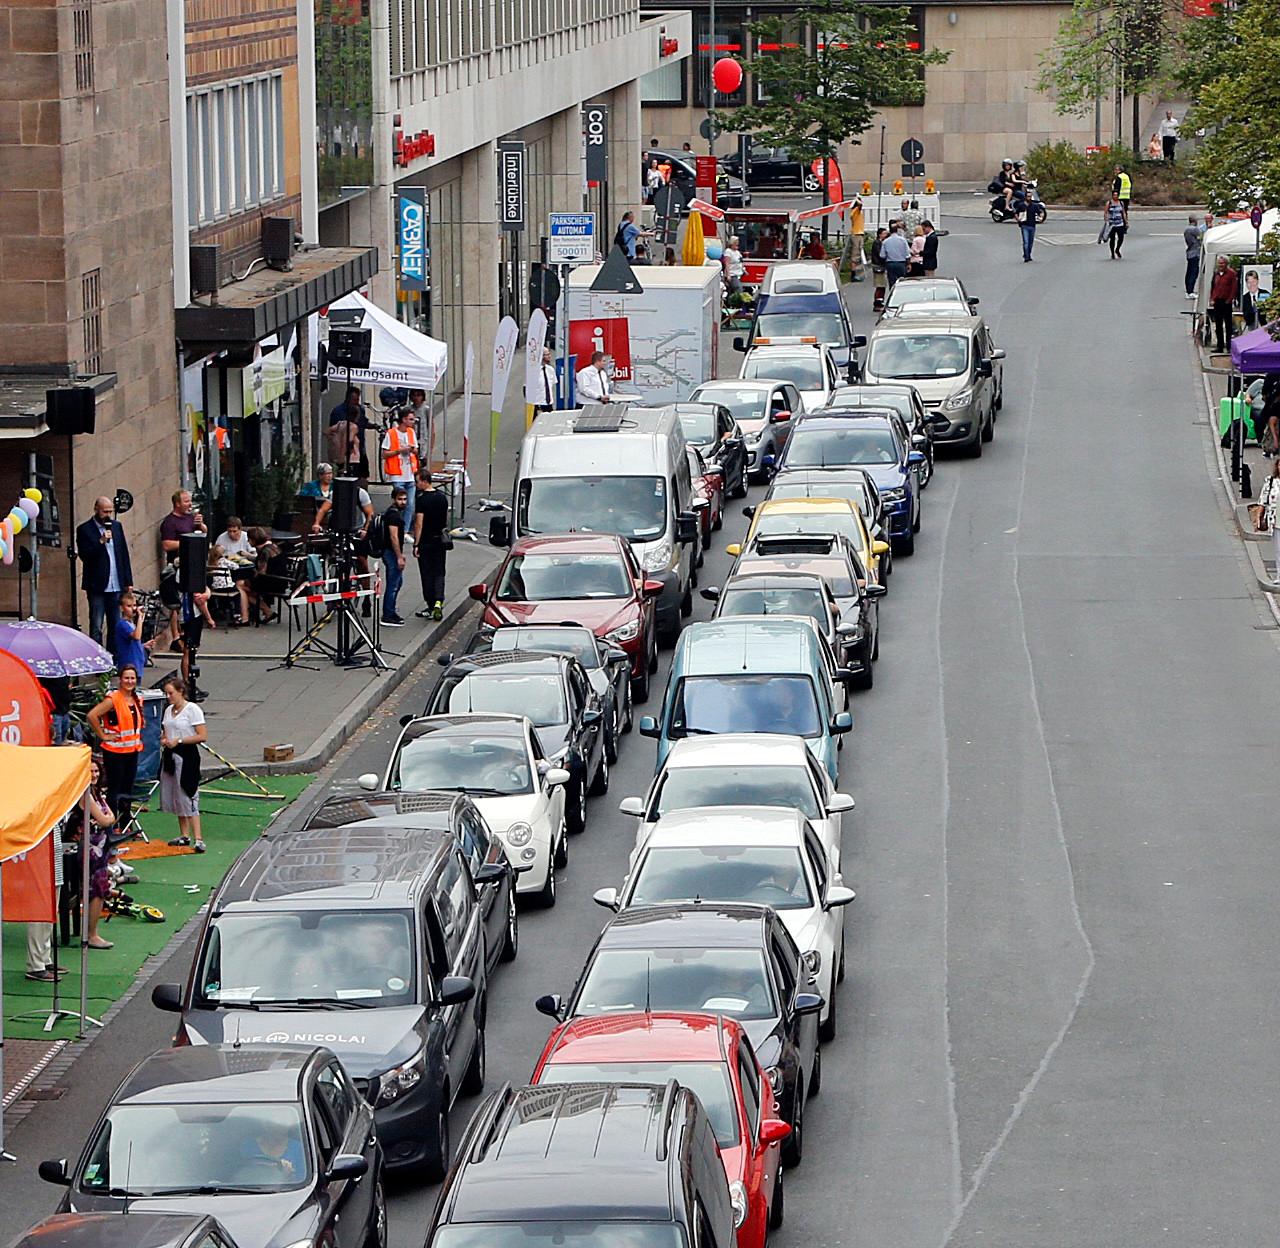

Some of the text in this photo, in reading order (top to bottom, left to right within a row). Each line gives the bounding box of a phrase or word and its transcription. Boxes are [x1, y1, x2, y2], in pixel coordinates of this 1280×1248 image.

[588, 110, 603, 145] COR
[507, 157, 518, 218] interlübke
[403, 204, 422, 274] CABINET
[557, 226, 586, 235] AUTOMAT
[557, 248, 587, 256] 500011
[295, 1034, 365, 1043] NICOLAI
